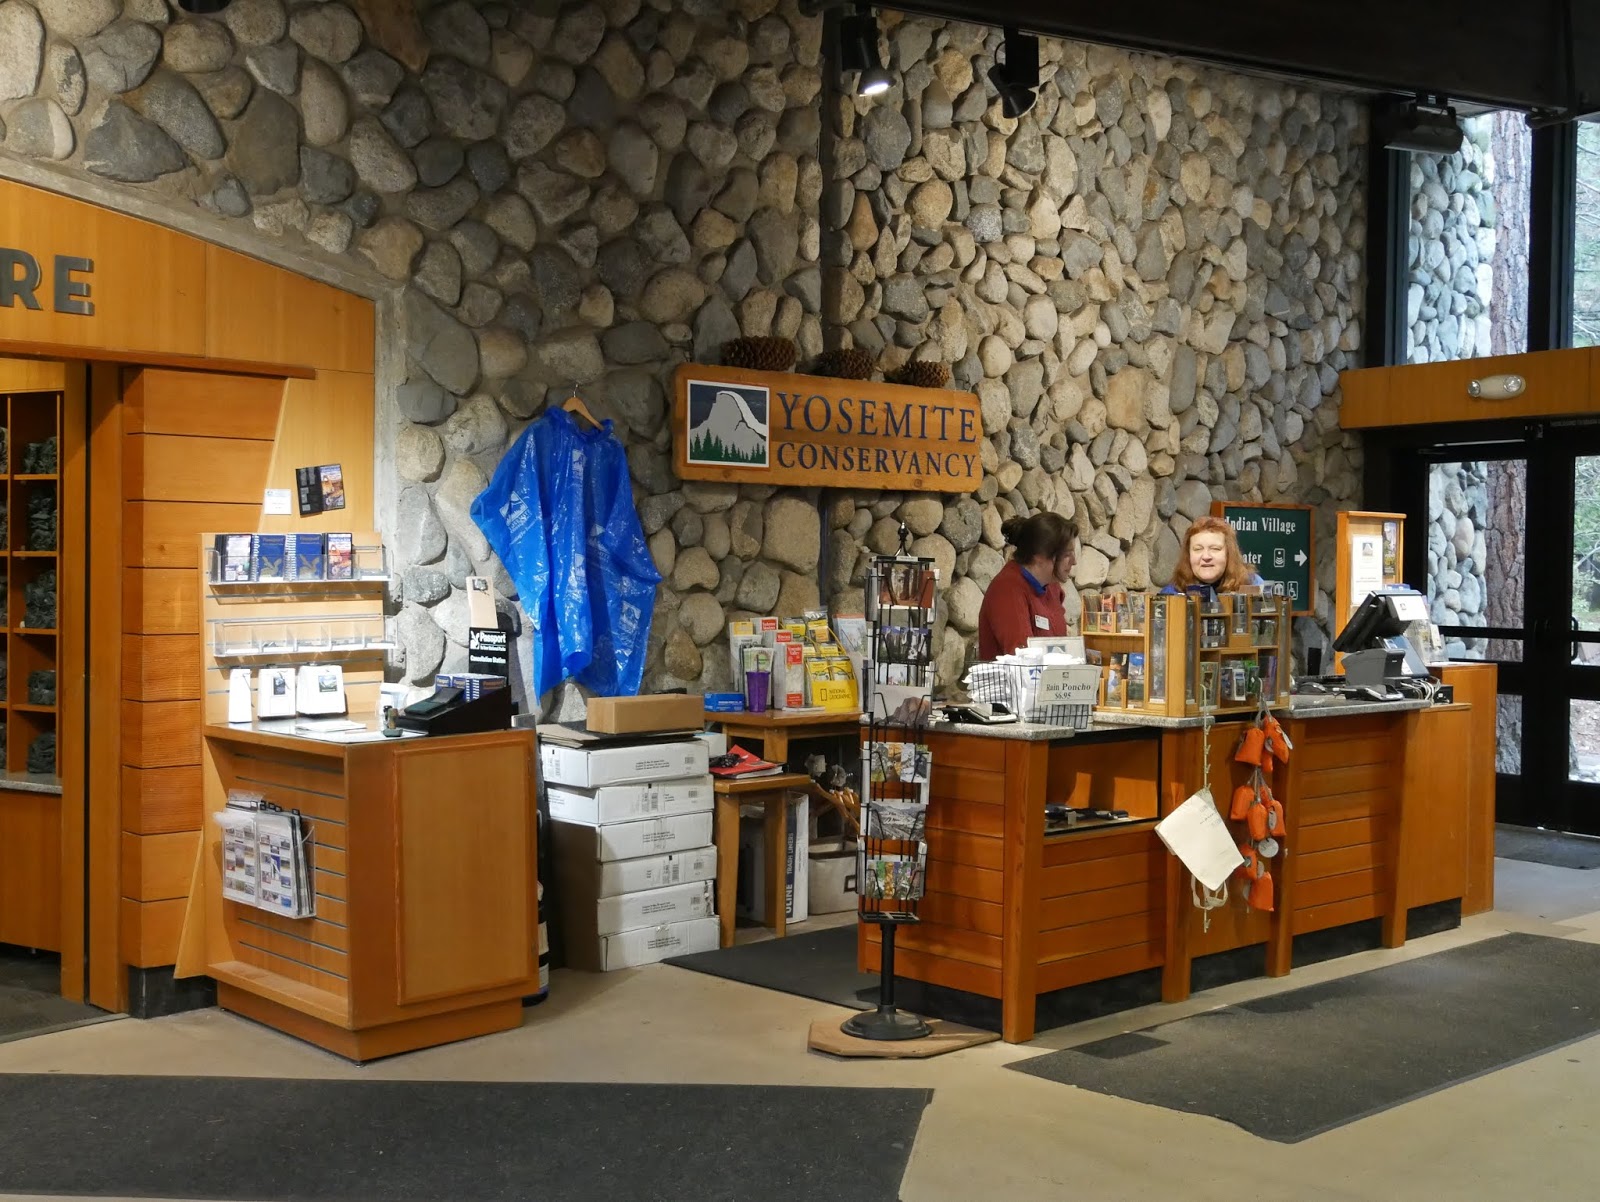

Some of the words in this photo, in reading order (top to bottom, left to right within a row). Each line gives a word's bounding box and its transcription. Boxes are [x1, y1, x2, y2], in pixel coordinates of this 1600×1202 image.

[776, 391, 977, 444] YOSEMITE
[777, 441, 977, 478] CONSERVANCY
[1261, 517, 1296, 535] Village
[1242, 551, 1262, 565] ater
[480, 631, 506, 645] Passport
[1046, 683, 1060, 691] Rain
[1062, 682, 1091, 691] Poncho
